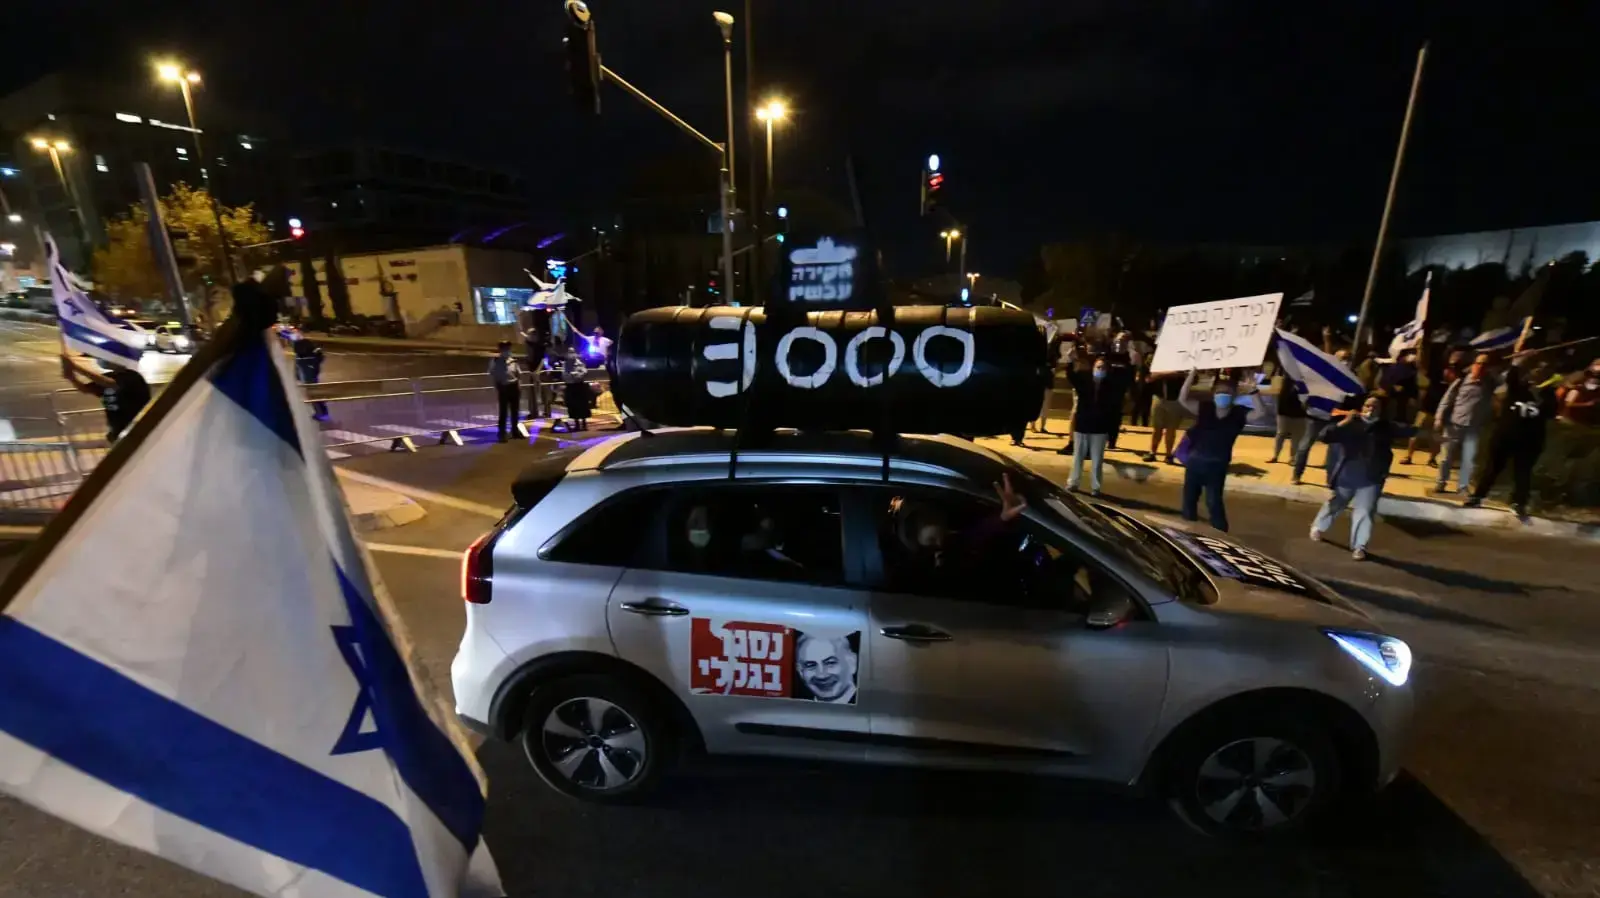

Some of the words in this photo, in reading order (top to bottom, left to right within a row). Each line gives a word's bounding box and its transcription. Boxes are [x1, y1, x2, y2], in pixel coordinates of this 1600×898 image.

[791, 262, 853, 283] חקירה
[789, 284, 852, 301] עכשיו
[703, 316, 975, 398] 3000
[698, 656, 783, 692] בגללי
